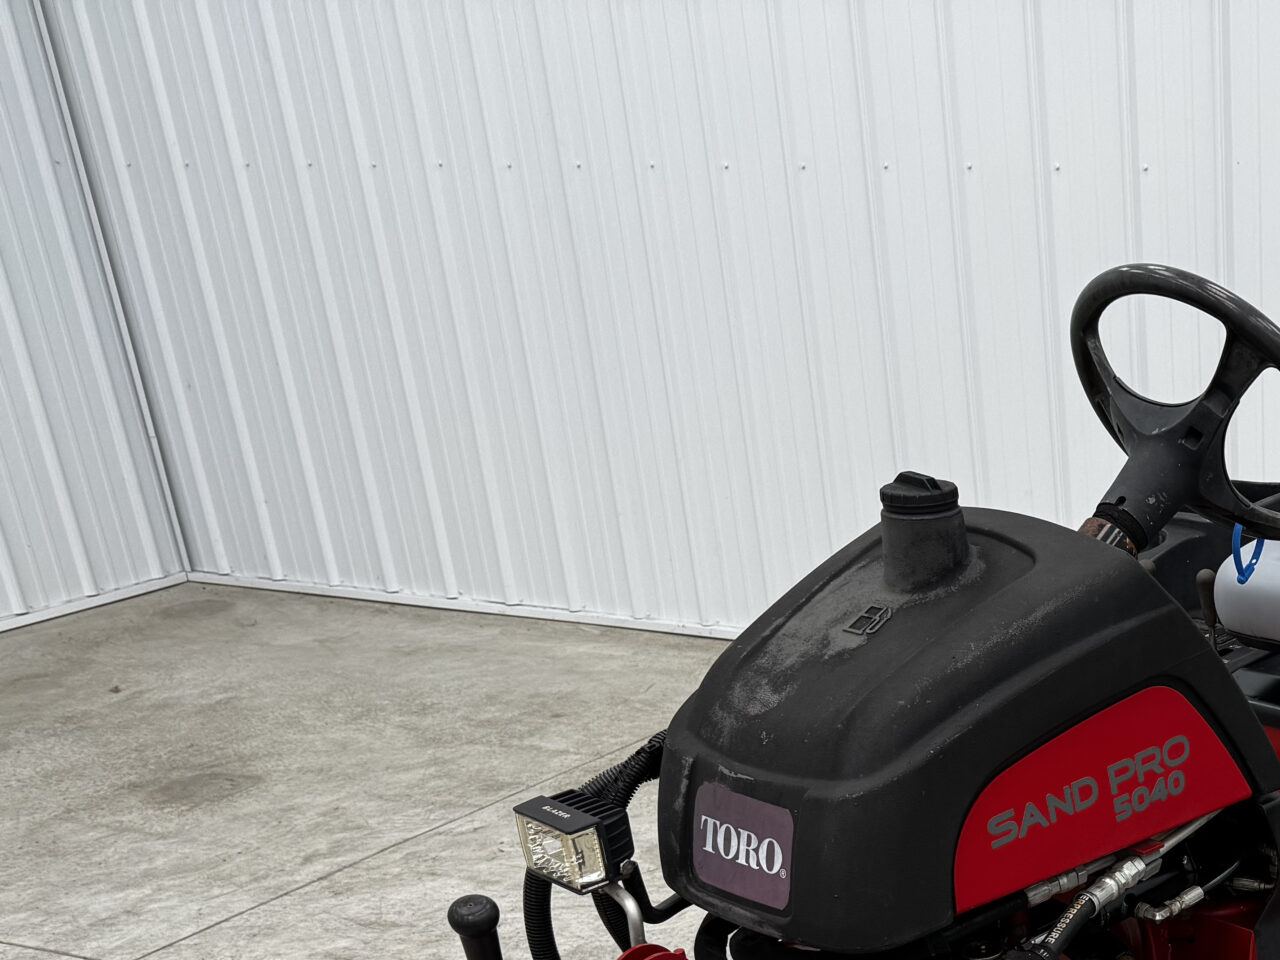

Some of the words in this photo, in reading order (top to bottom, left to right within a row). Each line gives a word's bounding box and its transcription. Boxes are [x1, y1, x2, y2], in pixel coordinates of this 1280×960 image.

[987, 776, 1099, 849] SAND
[1107, 735, 1190, 795] PRO
[1113, 770, 1186, 822] 5040
[701, 815, 783, 875] TORO
